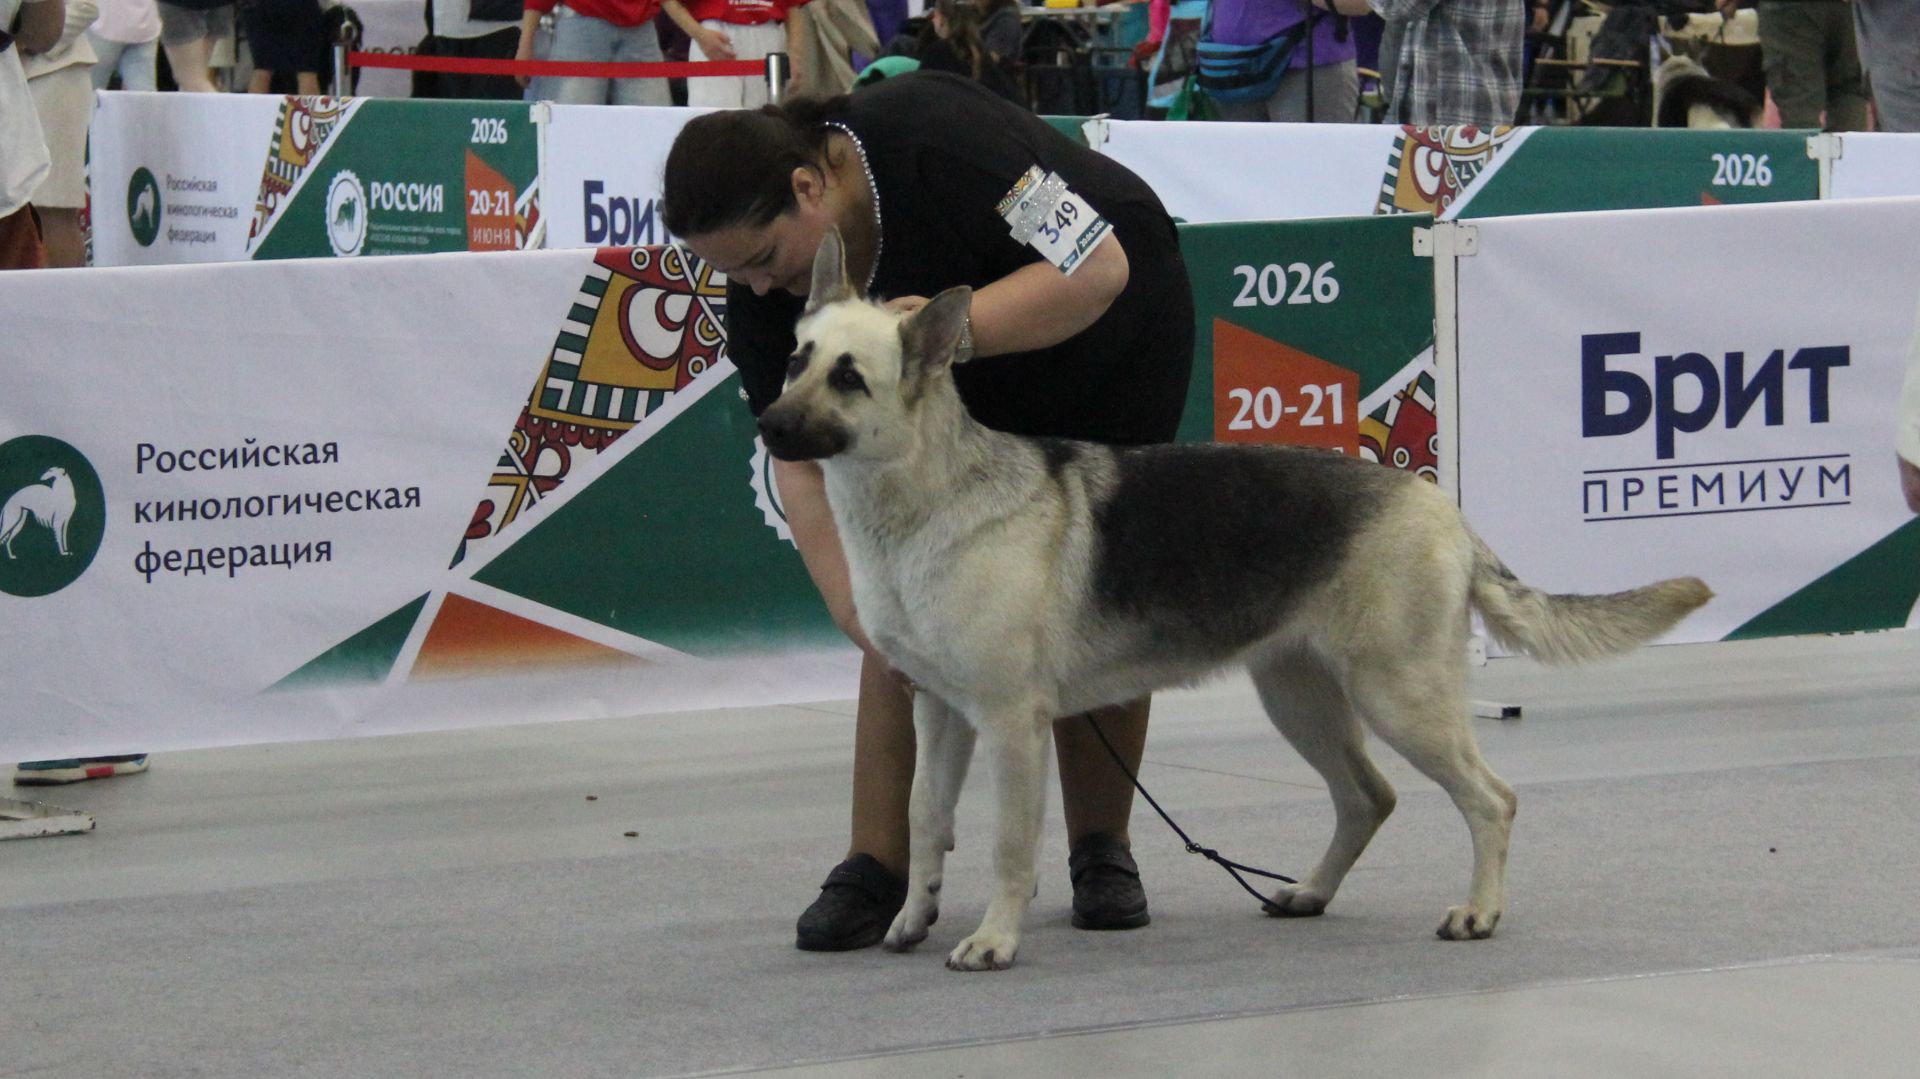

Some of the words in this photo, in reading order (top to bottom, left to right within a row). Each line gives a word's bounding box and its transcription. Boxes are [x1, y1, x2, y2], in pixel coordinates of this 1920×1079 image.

[471, 119, 508, 144] 2026
[167, 173, 217, 192] Российская
[1712, 153, 1772, 187] 2026
[167, 205, 238, 218] кинологическая
[370, 181, 443, 213] РОССИЯ
[469, 190, 511, 217] 20-21
[168, 224, 216, 246] федерация
[1038, 201, 1078, 244] 349
[1233, 261, 1339, 308] 2026
[1228, 383, 1344, 431] 20-21
[1582, 331, 1850, 460] Брит
[136, 438, 339, 474] Российская
[134, 486, 421, 524] кинологическая
[1583, 463, 1851, 515] ПРЕМИУМ
[134, 540, 332, 583] федерация
